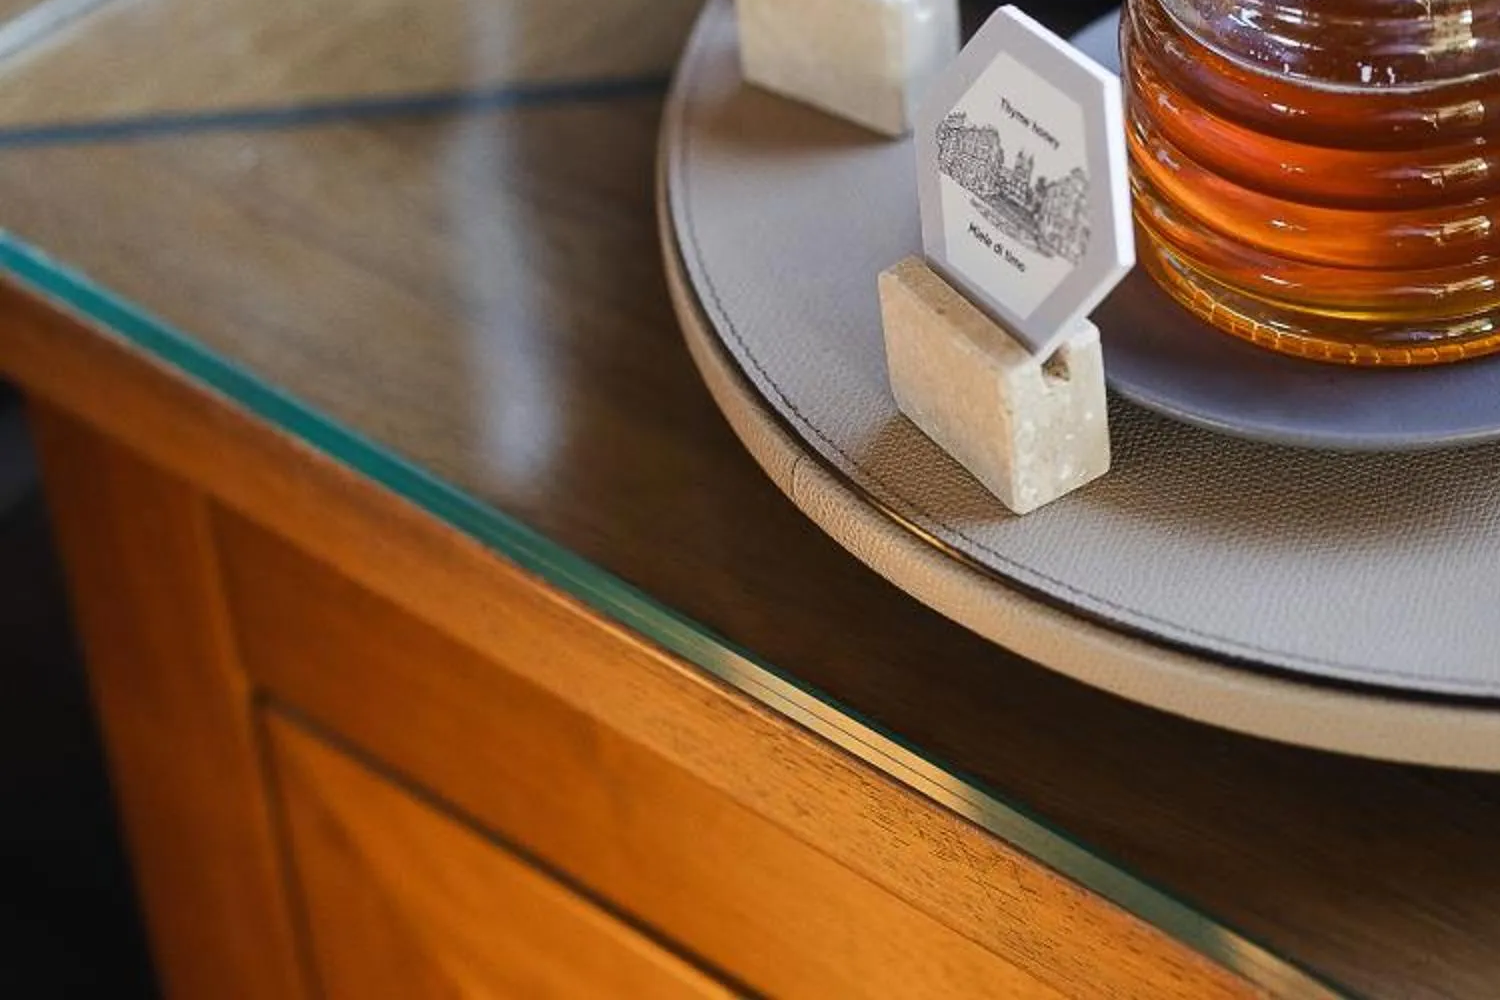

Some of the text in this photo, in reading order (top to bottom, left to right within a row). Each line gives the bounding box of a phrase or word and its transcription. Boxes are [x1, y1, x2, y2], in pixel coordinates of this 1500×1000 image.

[1001, 96, 1061, 151] Thyme honey
[968, 222, 993, 248] Miele
[1005, 249, 1027, 273] timo
